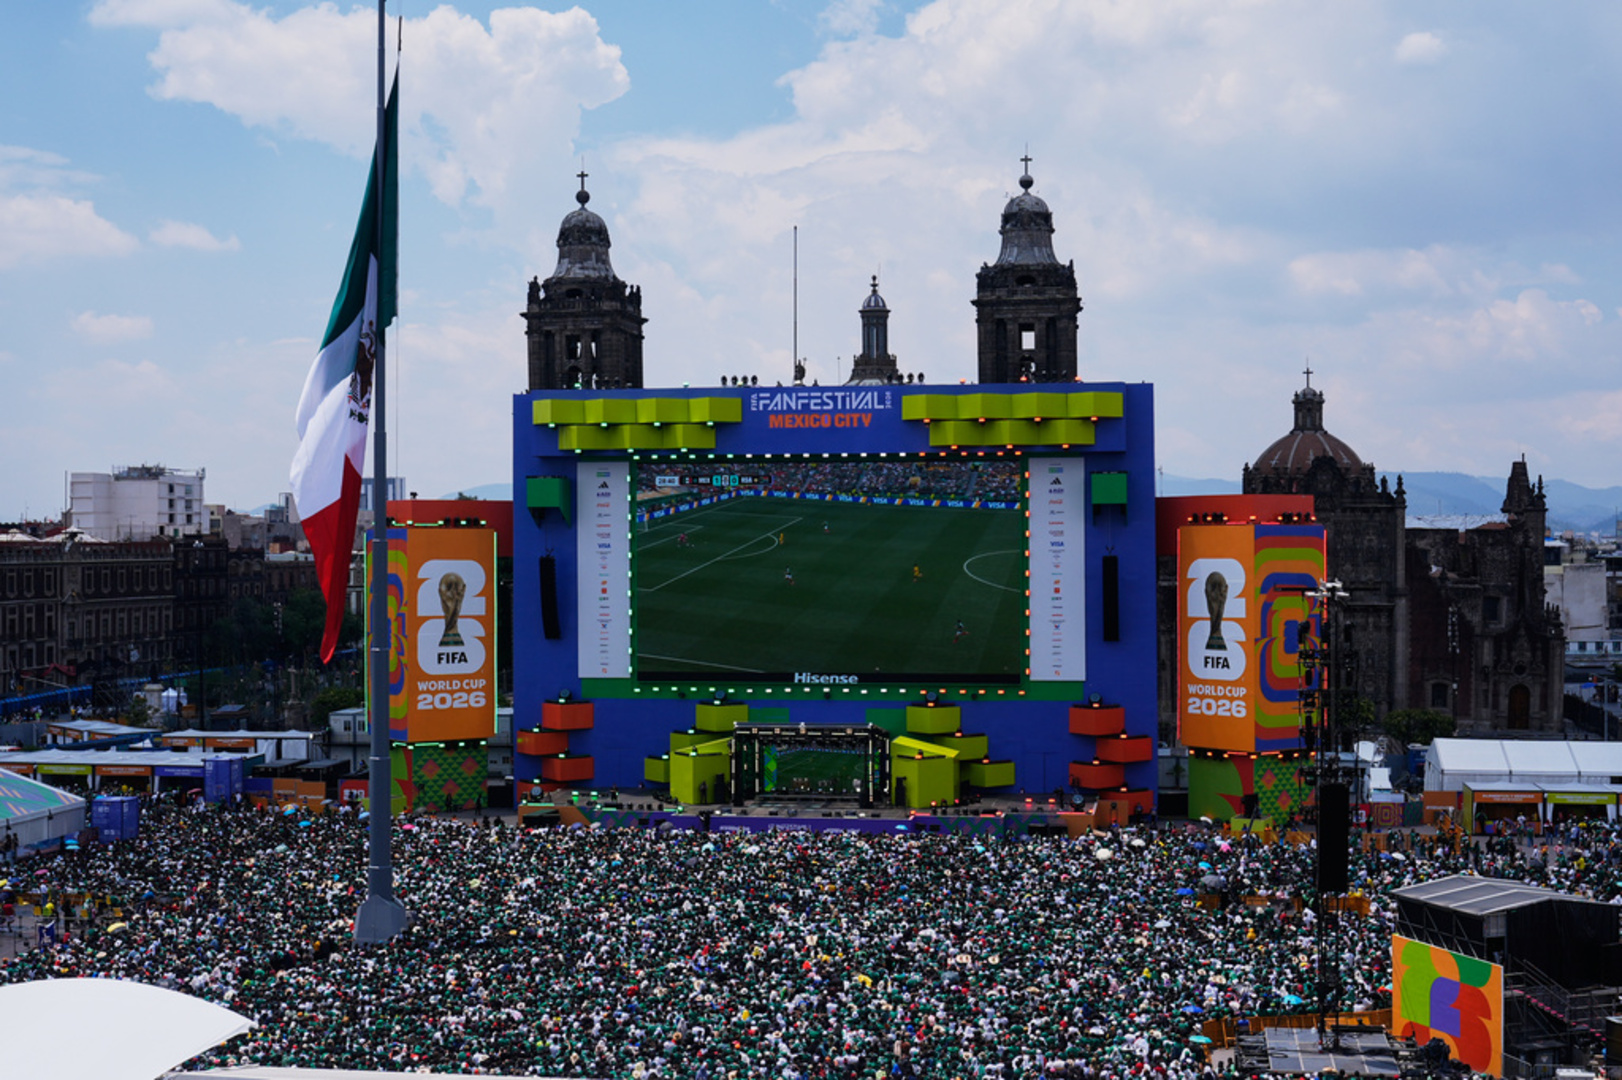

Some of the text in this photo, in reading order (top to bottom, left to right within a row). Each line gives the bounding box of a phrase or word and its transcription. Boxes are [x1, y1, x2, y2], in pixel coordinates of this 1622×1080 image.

[769, 413, 872, 428] MEXICO CITY
[437, 652, 468, 665] FIFA
[1203, 656, 1231, 670] FIFA
[417, 678, 487, 692] WORLD CUP
[794, 672, 859, 684] Hisense
[1187, 684, 1248, 698] WORLD CUP
[416, 691, 487, 711] 2026
[1187, 697, 1248, 718] 2026
